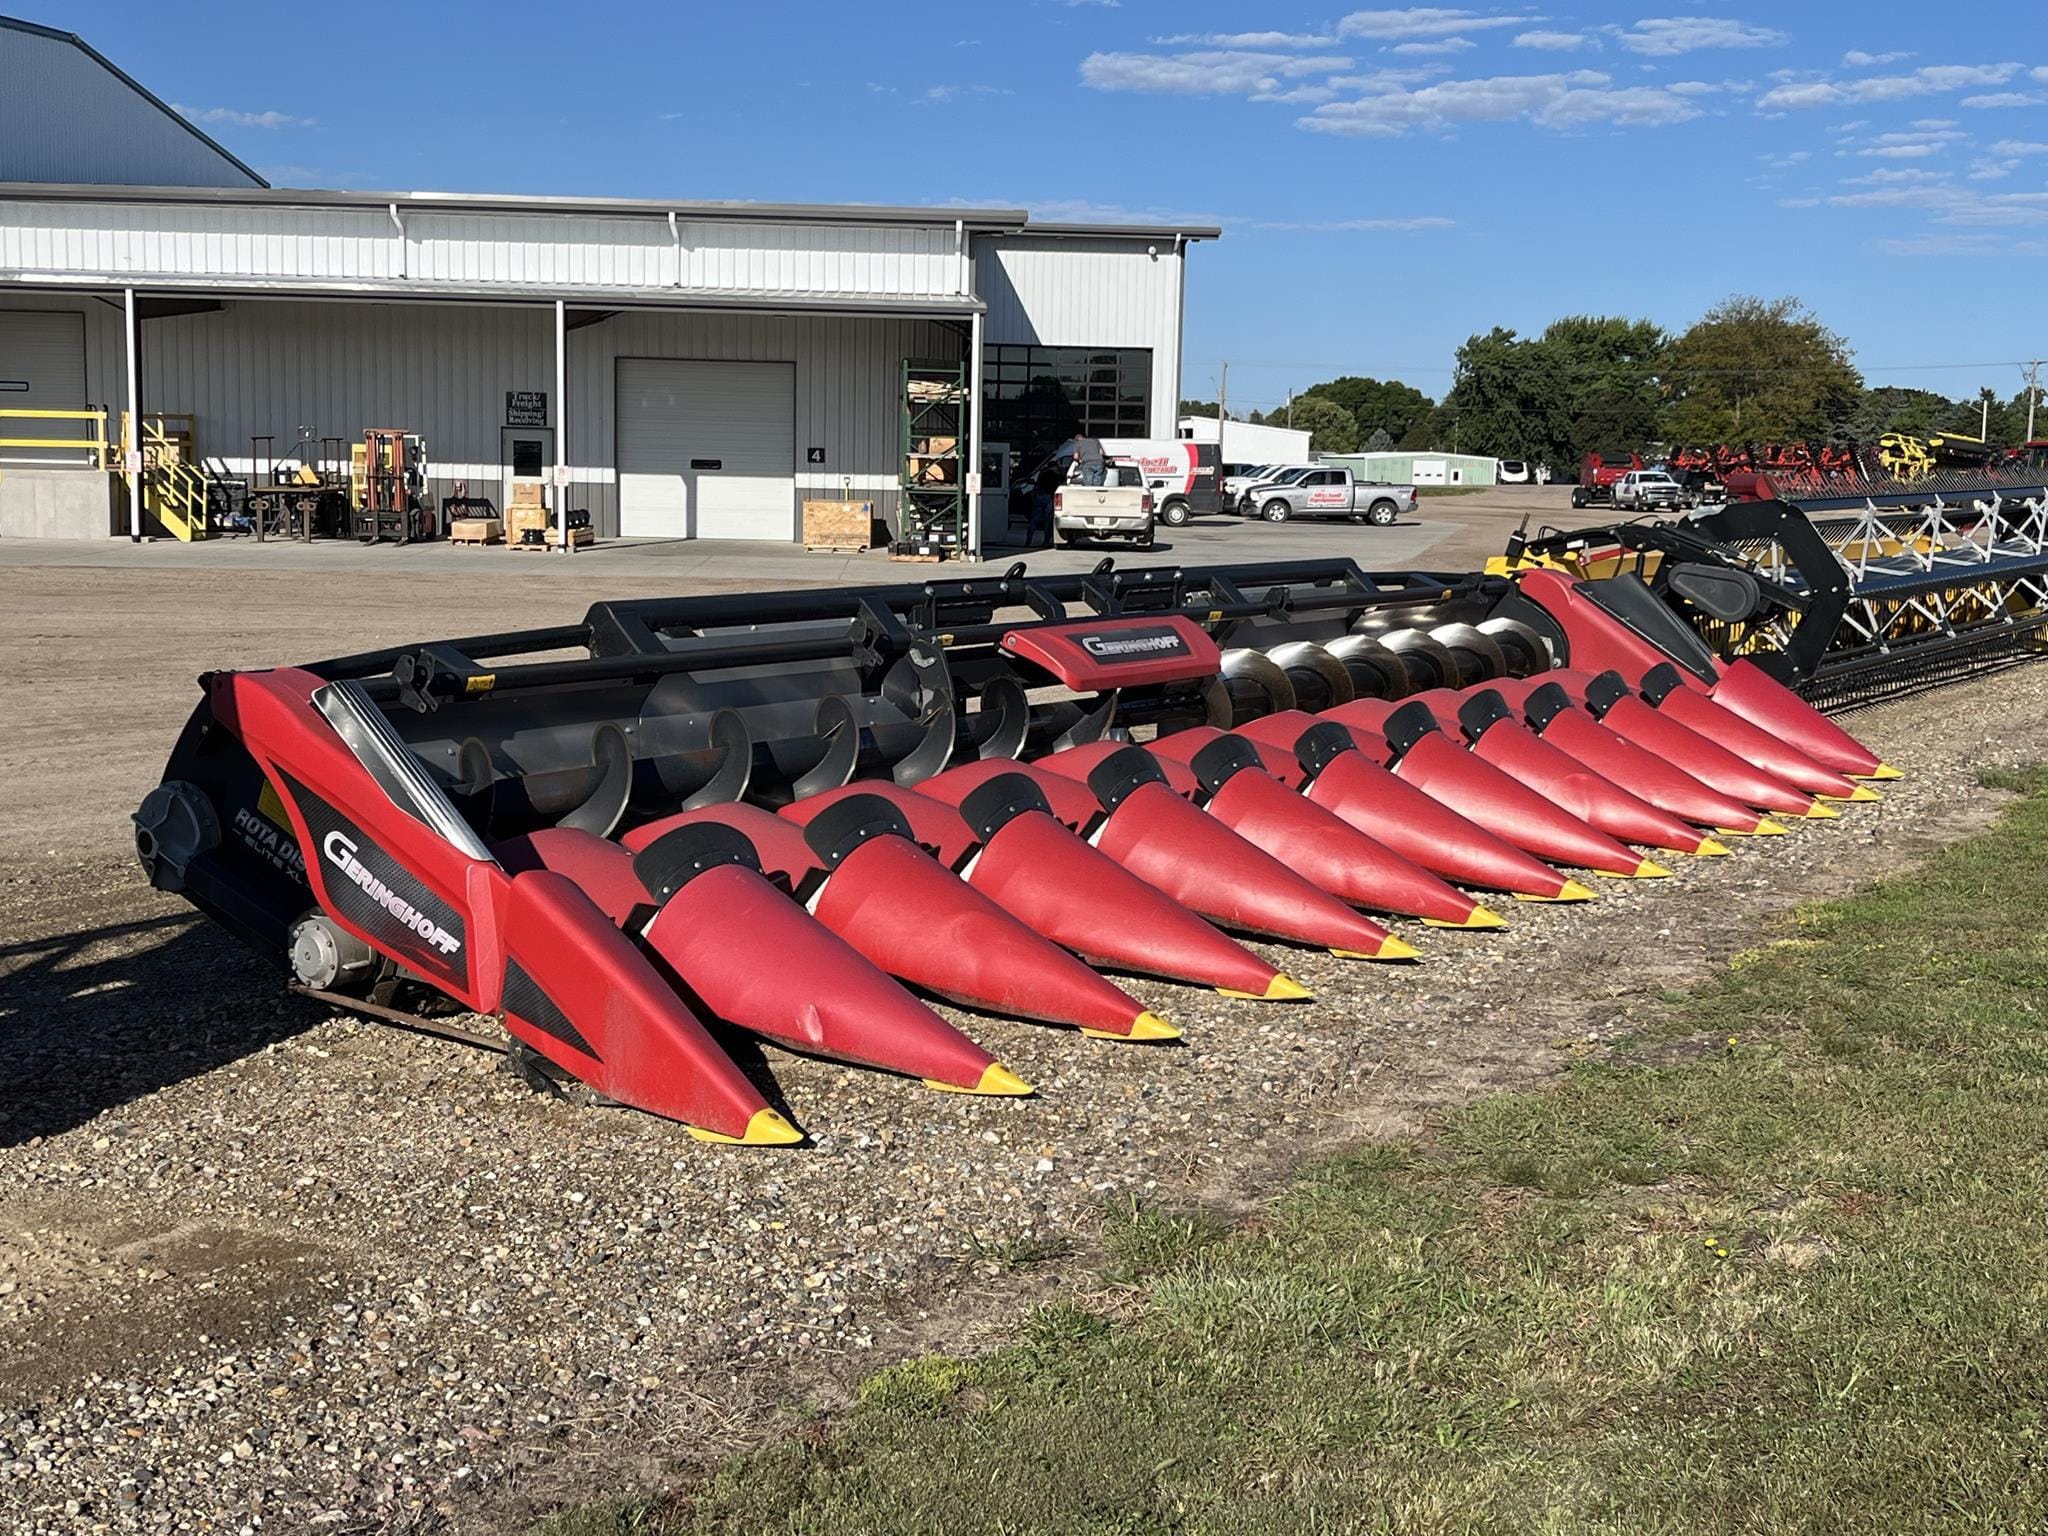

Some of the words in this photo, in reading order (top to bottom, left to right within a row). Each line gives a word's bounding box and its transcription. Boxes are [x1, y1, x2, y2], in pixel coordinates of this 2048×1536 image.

[512, 392, 541, 401] Truck/
[512, 399, 542, 409] Freight
[508, 409, 545, 419] Shipping/
[508, 417, 545, 426] Receiving
[811, 450, 821, 462] 4
[234, 807, 279, 850] ROTA
[277, 840, 306, 872] DIS
[244, 835, 284, 870] ELITE
[285, 865, 303, 885] XL
[323, 830, 462, 955] GERINGHOFF
